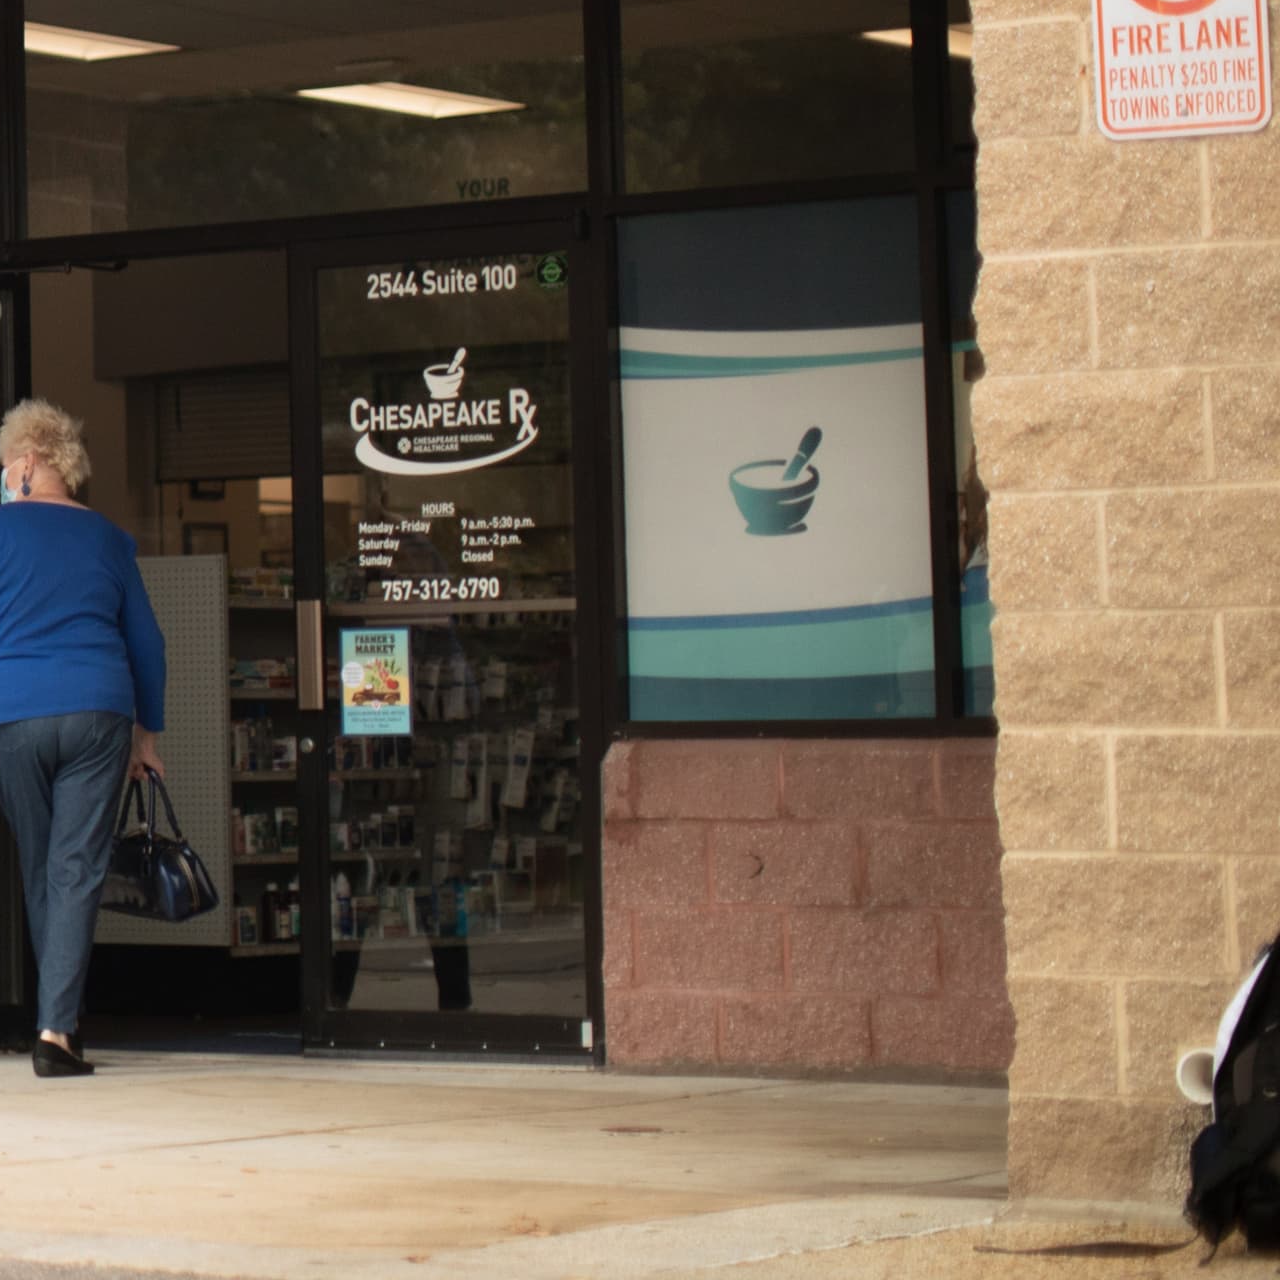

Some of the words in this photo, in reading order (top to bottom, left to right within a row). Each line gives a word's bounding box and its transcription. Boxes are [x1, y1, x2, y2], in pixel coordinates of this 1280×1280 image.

[1112, 23, 1172, 57] FIRE
[1180, 16, 1251, 52] LANE
[1109, 64, 1175, 91] PENALTY
[1181, 61, 1218, 89] $250
[1224, 58, 1256, 84] FINE
[1110, 95, 1170, 121] TOWING
[1175, 89, 1256, 117] ENFORCED
[456, 177, 510, 199] YOUR
[367, 271, 417, 299] 2544
[422, 268, 477, 295] Suite
[481, 264, 516, 291] 100
[350, 397, 501, 432] CHESAPEAKE
[413, 435, 458, 445] CHESAPEAKE
[460, 434, 494, 443] REGIONAL
[413, 443, 459, 453] HEALTHCARE
[422, 503, 455, 516] HOURS
[359, 523, 393, 535] Monday
[401, 521, 431, 534] Friday
[461, 518, 466, 530] 9
[514, 517, 535, 530] p.m.
[359, 539, 400, 551] Saturday
[461, 535, 467, 547] 9
[500, 534, 522, 547] p.m.
[359, 554, 393, 567] Sunday
[462, 550, 494, 563] Closed
[382, 577, 500, 602] 757-312-6790
[356, 644, 395, 654] MARKET
